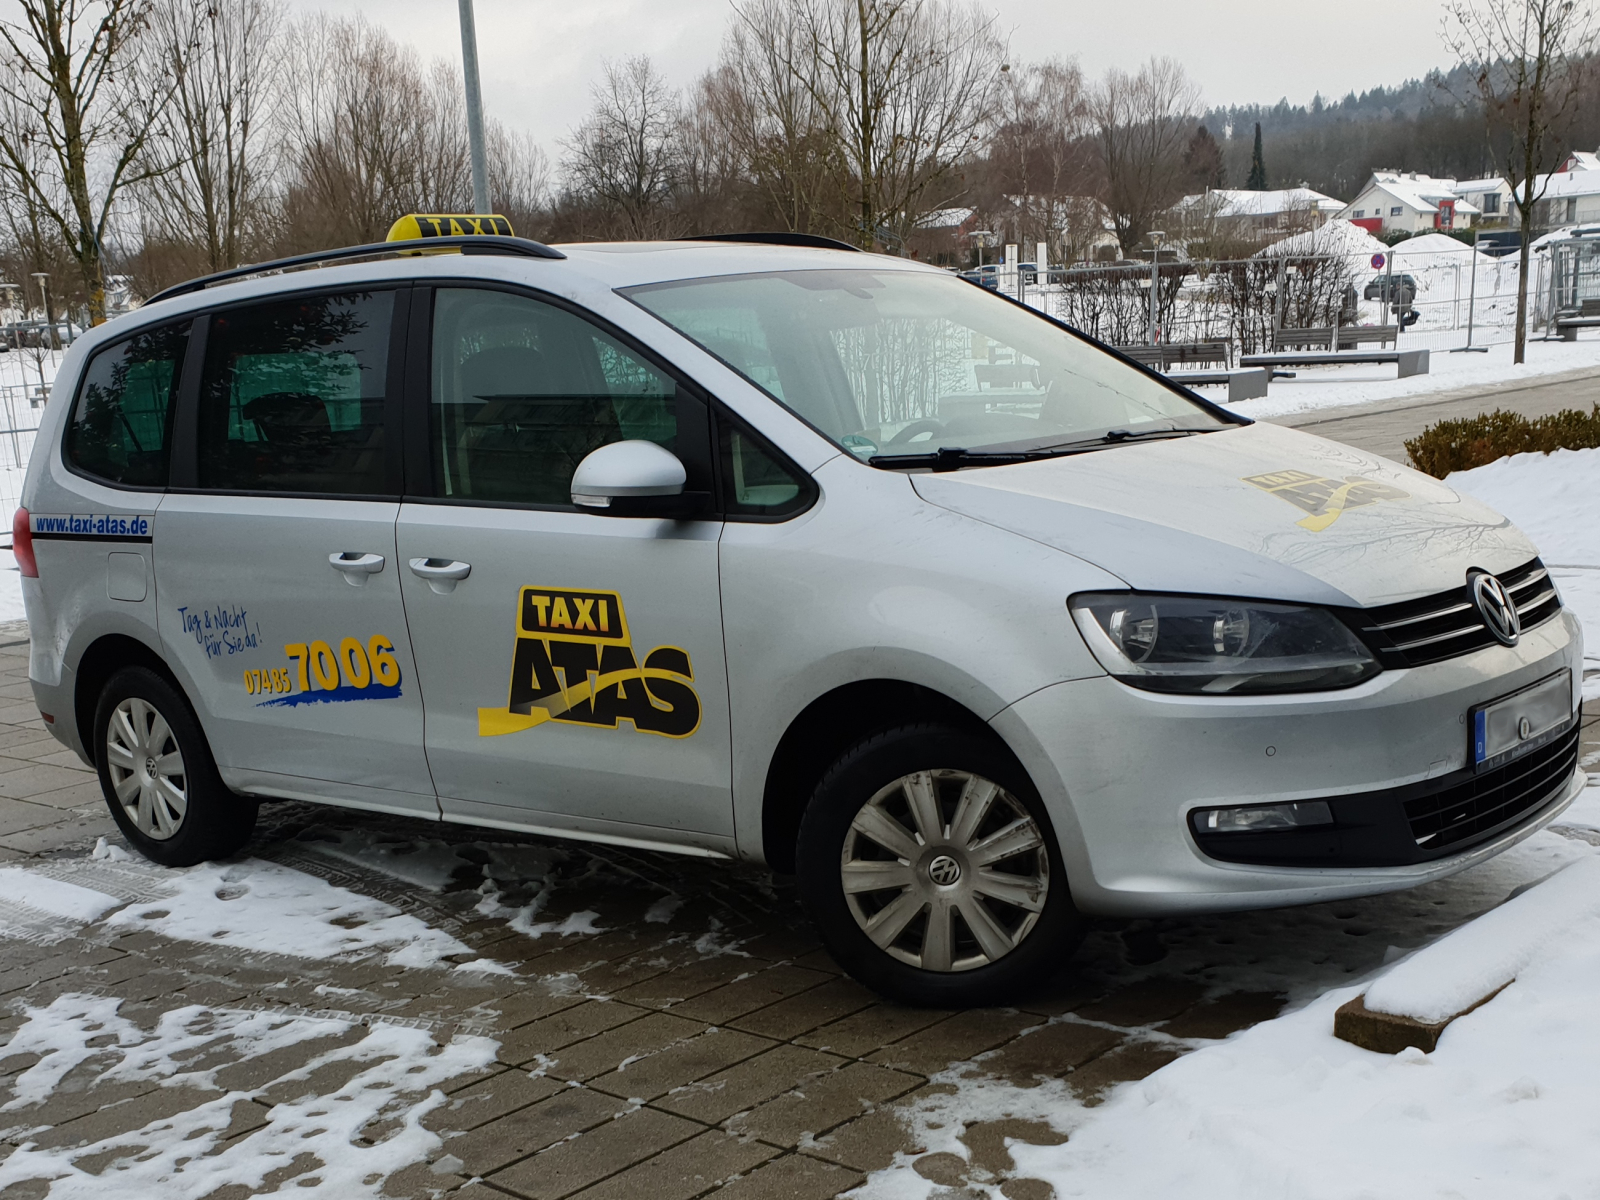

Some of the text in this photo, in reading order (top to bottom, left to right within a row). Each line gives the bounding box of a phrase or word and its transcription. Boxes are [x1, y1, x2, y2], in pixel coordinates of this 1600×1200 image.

[426, 218, 499, 236] TAXI
[1250, 470, 1312, 487] TAXI
[36, 514, 148, 535] www.taxi-atas.de
[177, 604, 248, 645] Tag & Nacht
[531, 595, 609, 632] TAXI
[243, 634, 402, 695] 07485 7006
[509, 636, 701, 737] ATAS
